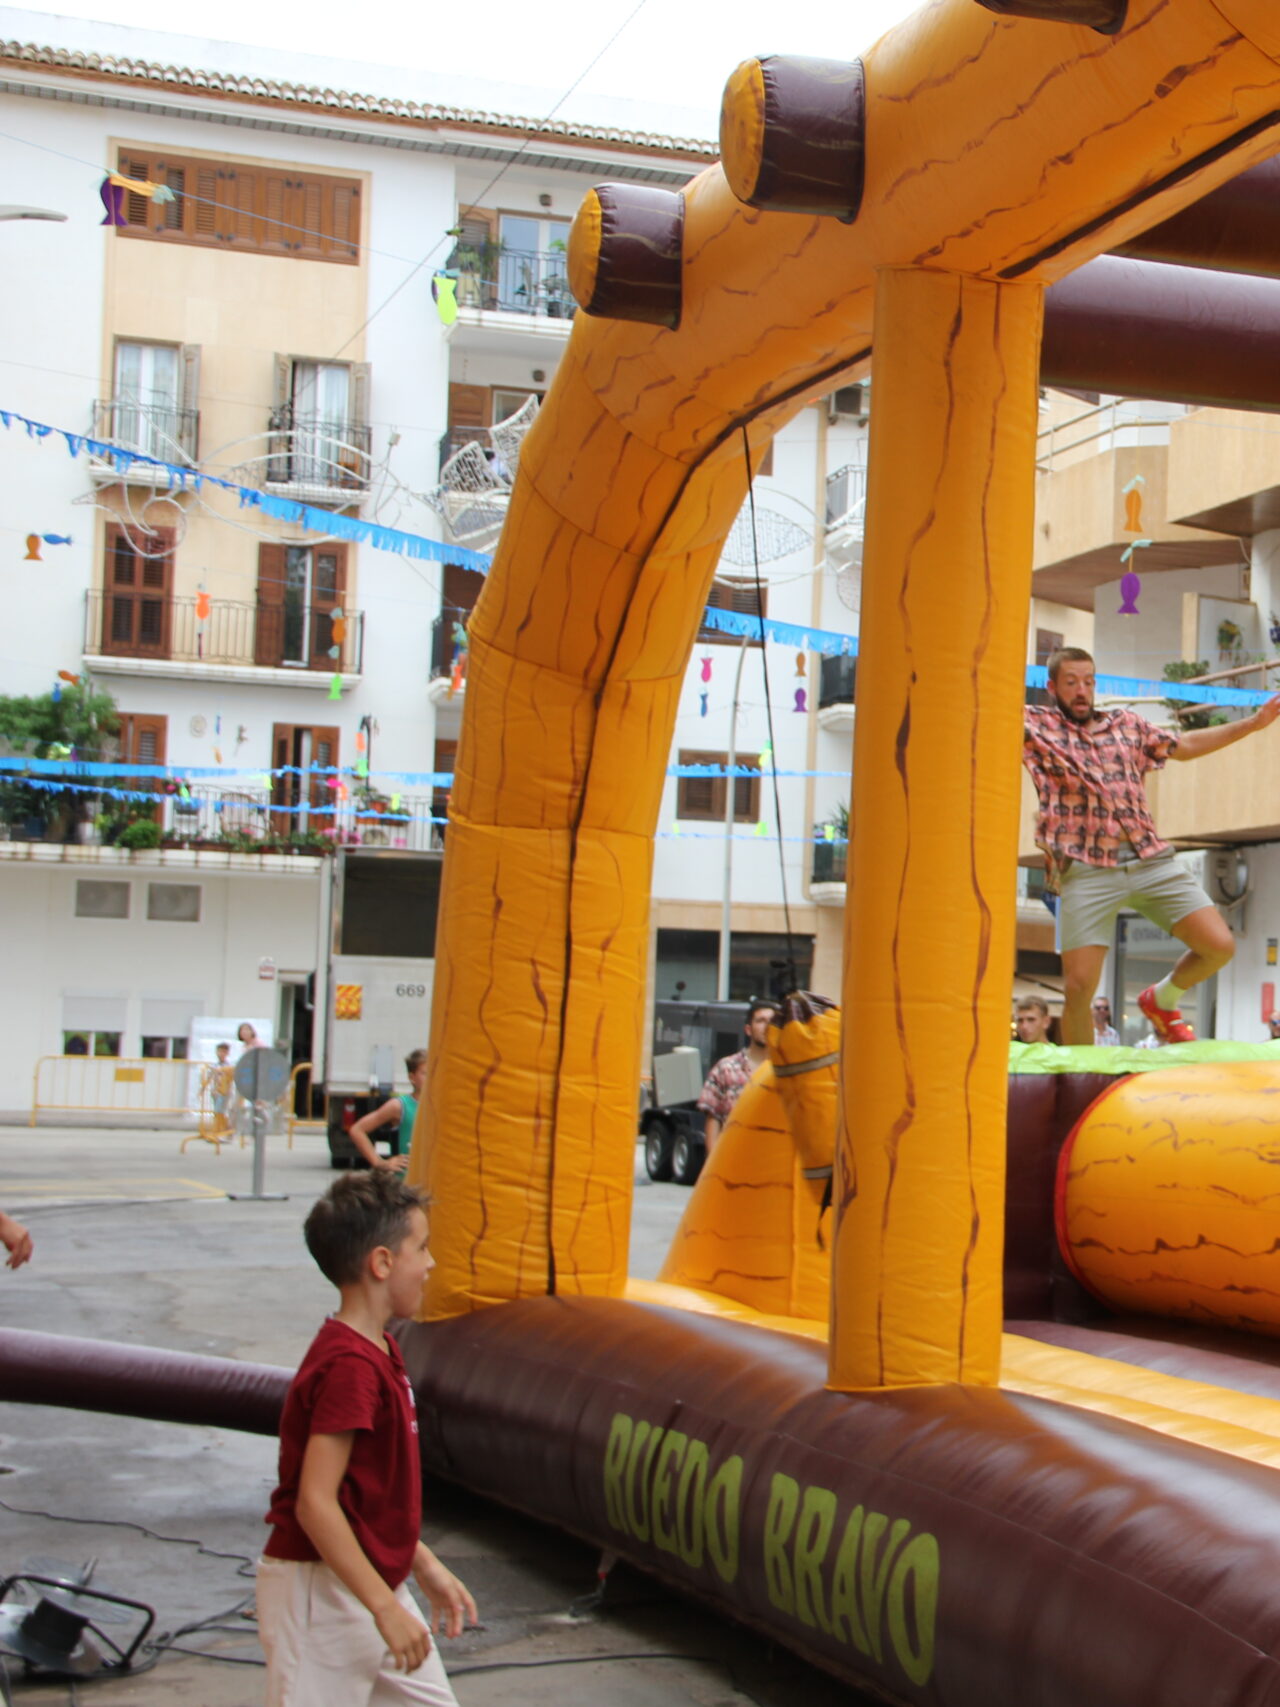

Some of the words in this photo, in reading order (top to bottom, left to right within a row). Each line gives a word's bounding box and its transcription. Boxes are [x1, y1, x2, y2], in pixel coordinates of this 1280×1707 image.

[396, 984, 426, 998] 669
[603, 1412, 744, 1584] RUEDO
[763, 1472, 941, 1687] BRAVO
